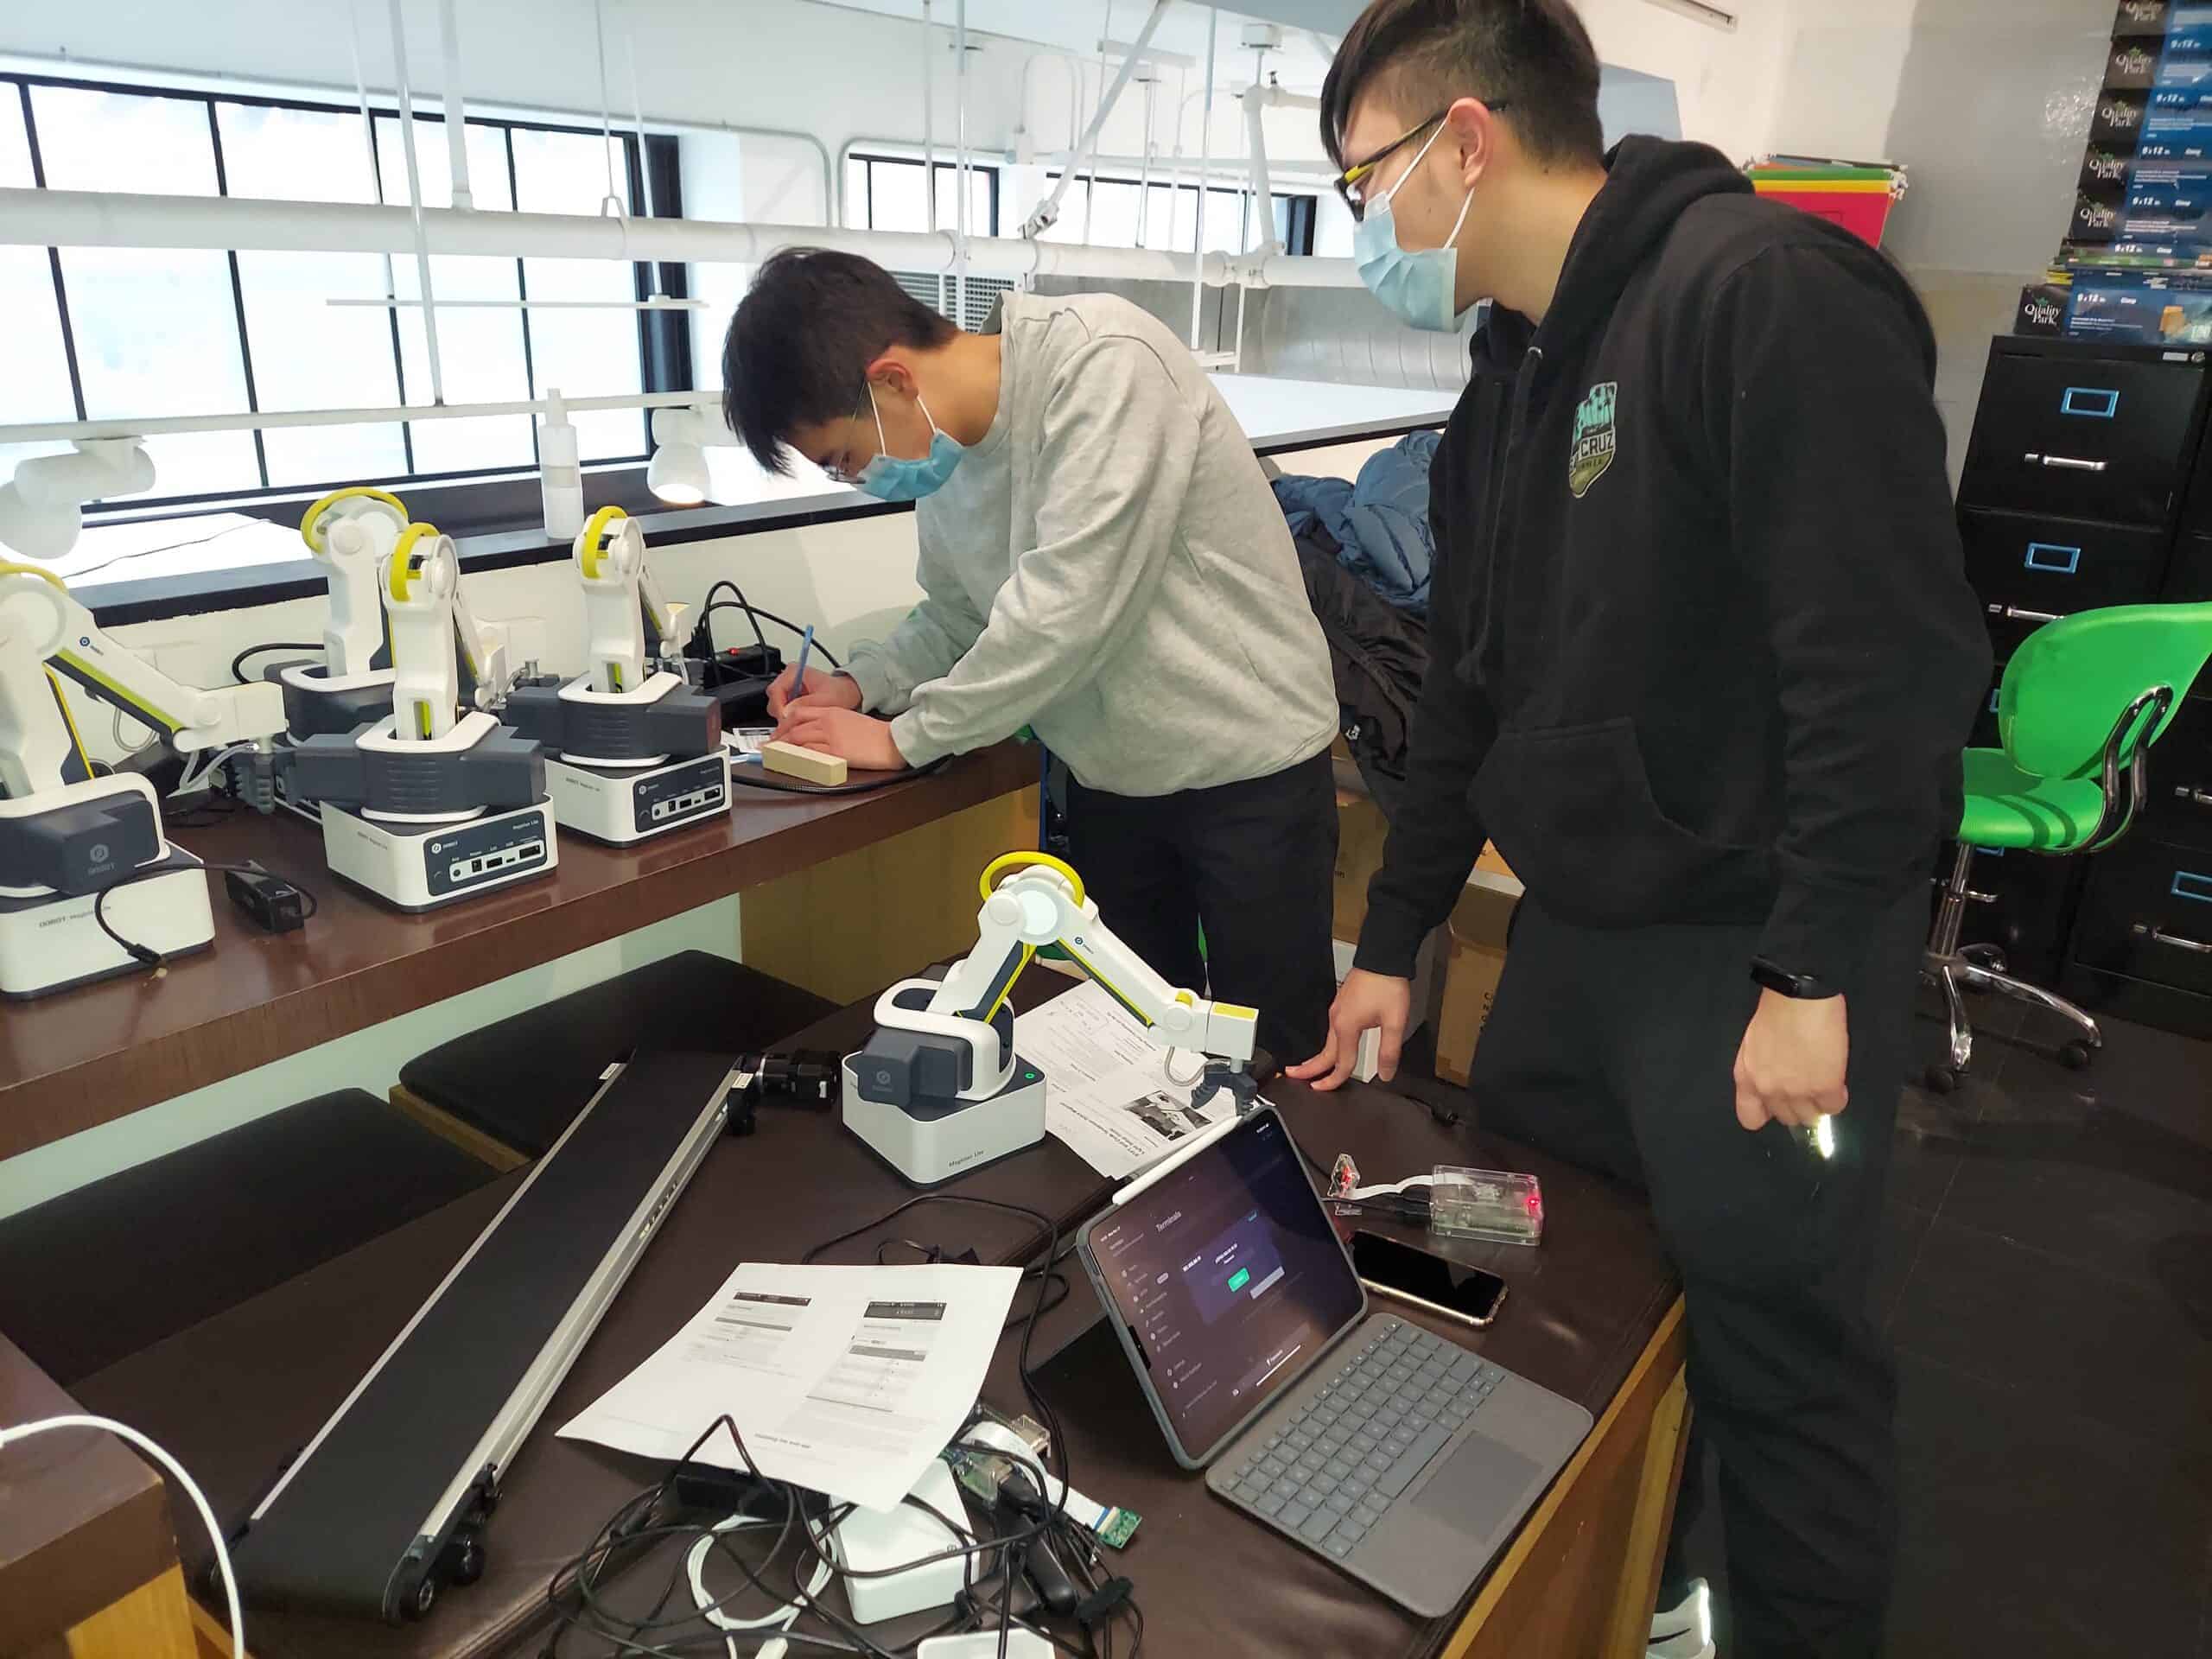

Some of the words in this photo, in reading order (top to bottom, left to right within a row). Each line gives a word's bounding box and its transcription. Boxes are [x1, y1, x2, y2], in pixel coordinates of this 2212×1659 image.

[2101, 106, 2137, 120] Quality
[2088, 158, 2123, 172] Quality
[2080, 207, 2115, 221] Quality
[2024, 303, 2061, 318] Quality
[2032, 312, 2055, 326] Park
[1581, 433, 1613, 457] CRUZ
